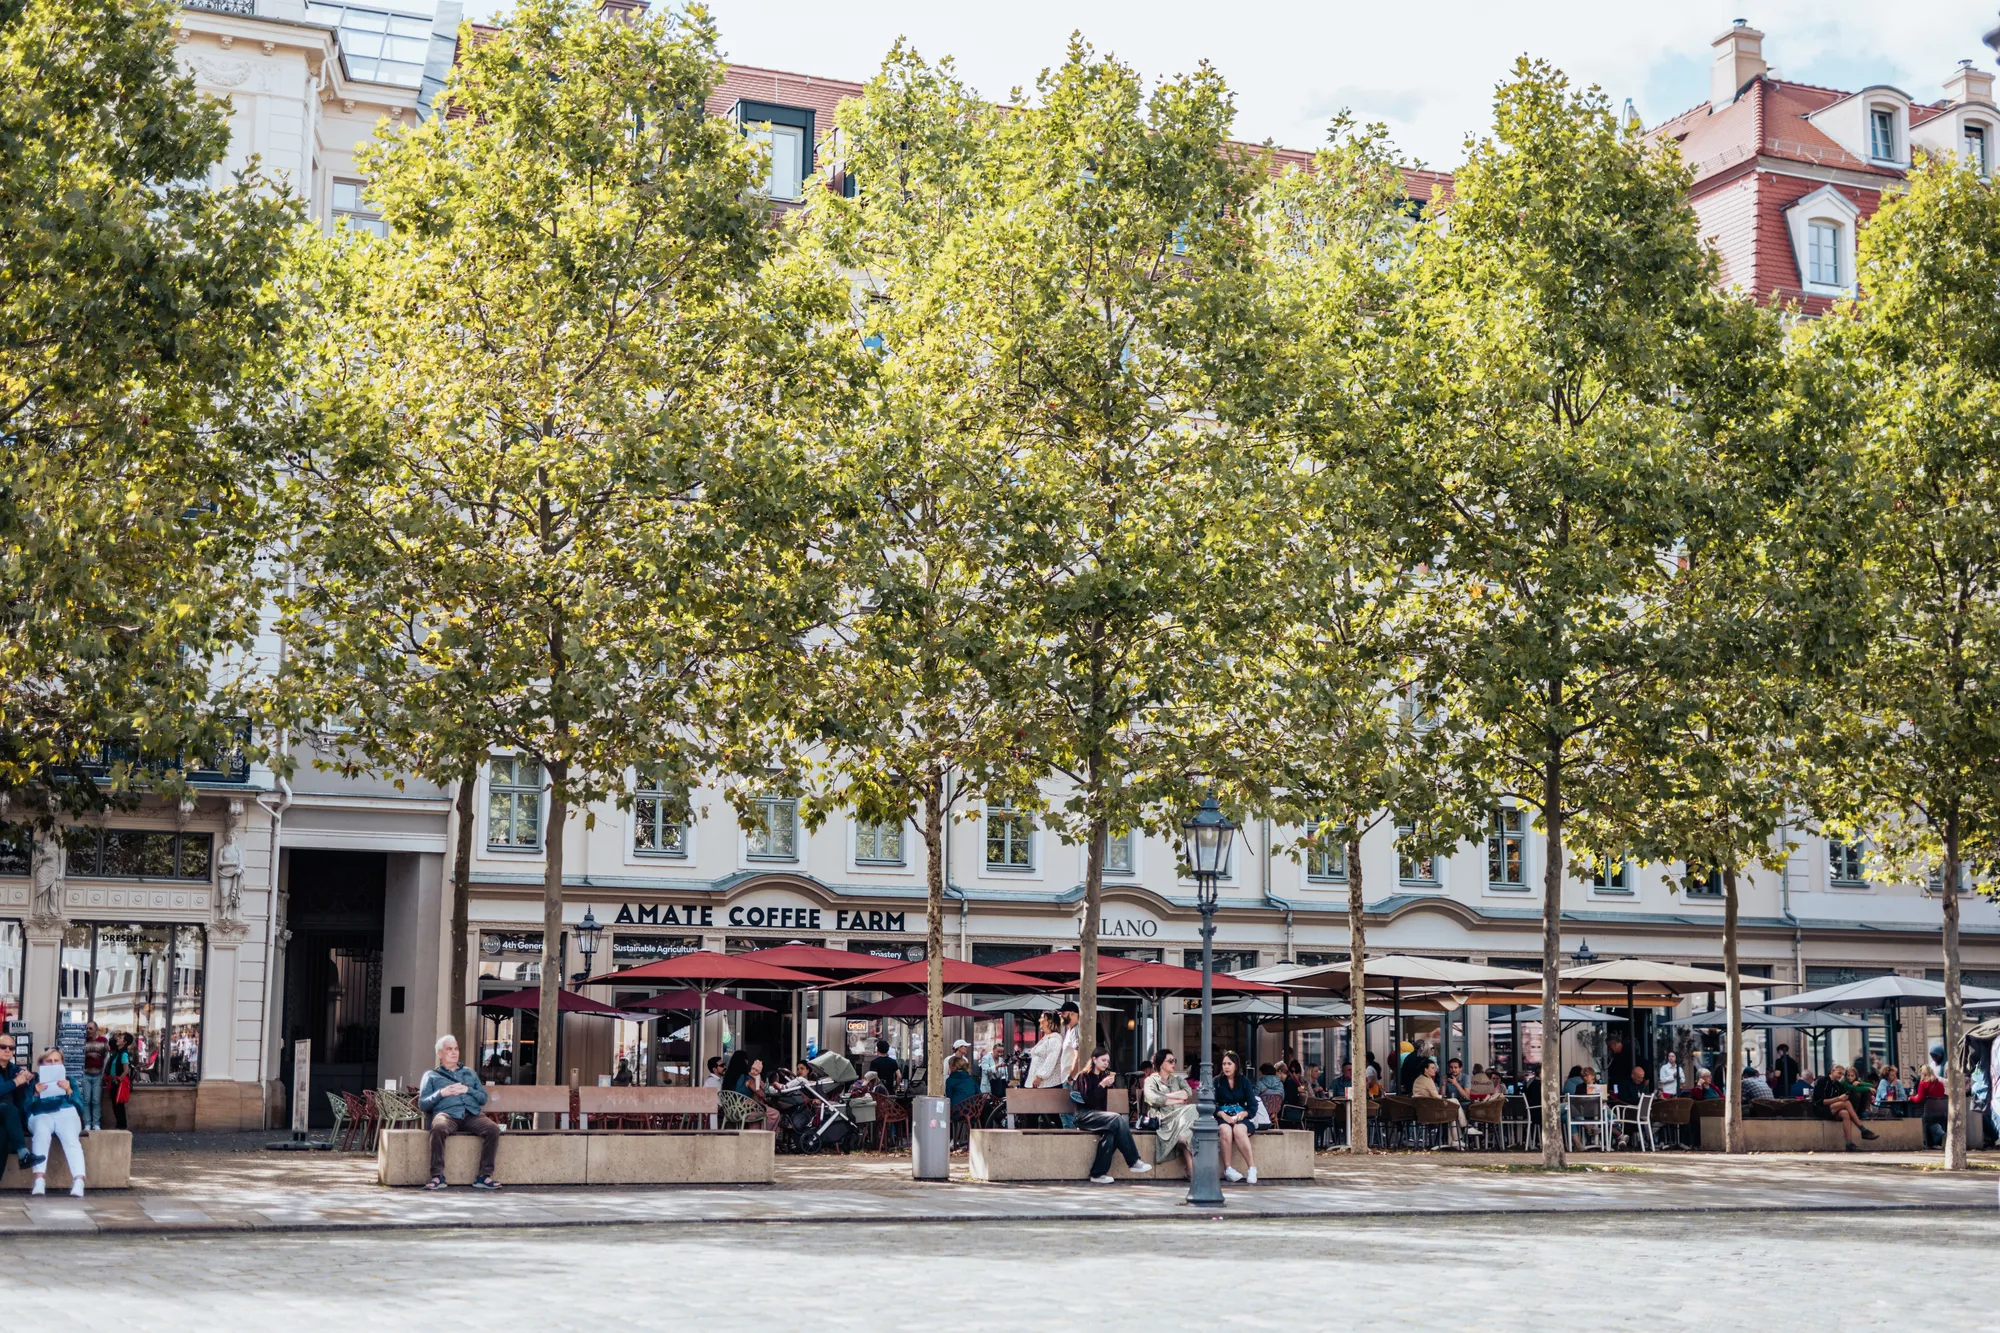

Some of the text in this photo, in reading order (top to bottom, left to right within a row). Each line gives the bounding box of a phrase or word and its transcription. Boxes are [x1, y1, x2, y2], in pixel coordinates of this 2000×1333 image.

[614, 903, 906, 932] AMATE COFFEE FARM
[102, 934, 147, 942] DRESDEN
[502, 941, 517, 949] 4th
[613, 943, 699, 955] Sustainable Agriculture
[848, 1022, 866, 1030] OPEN
